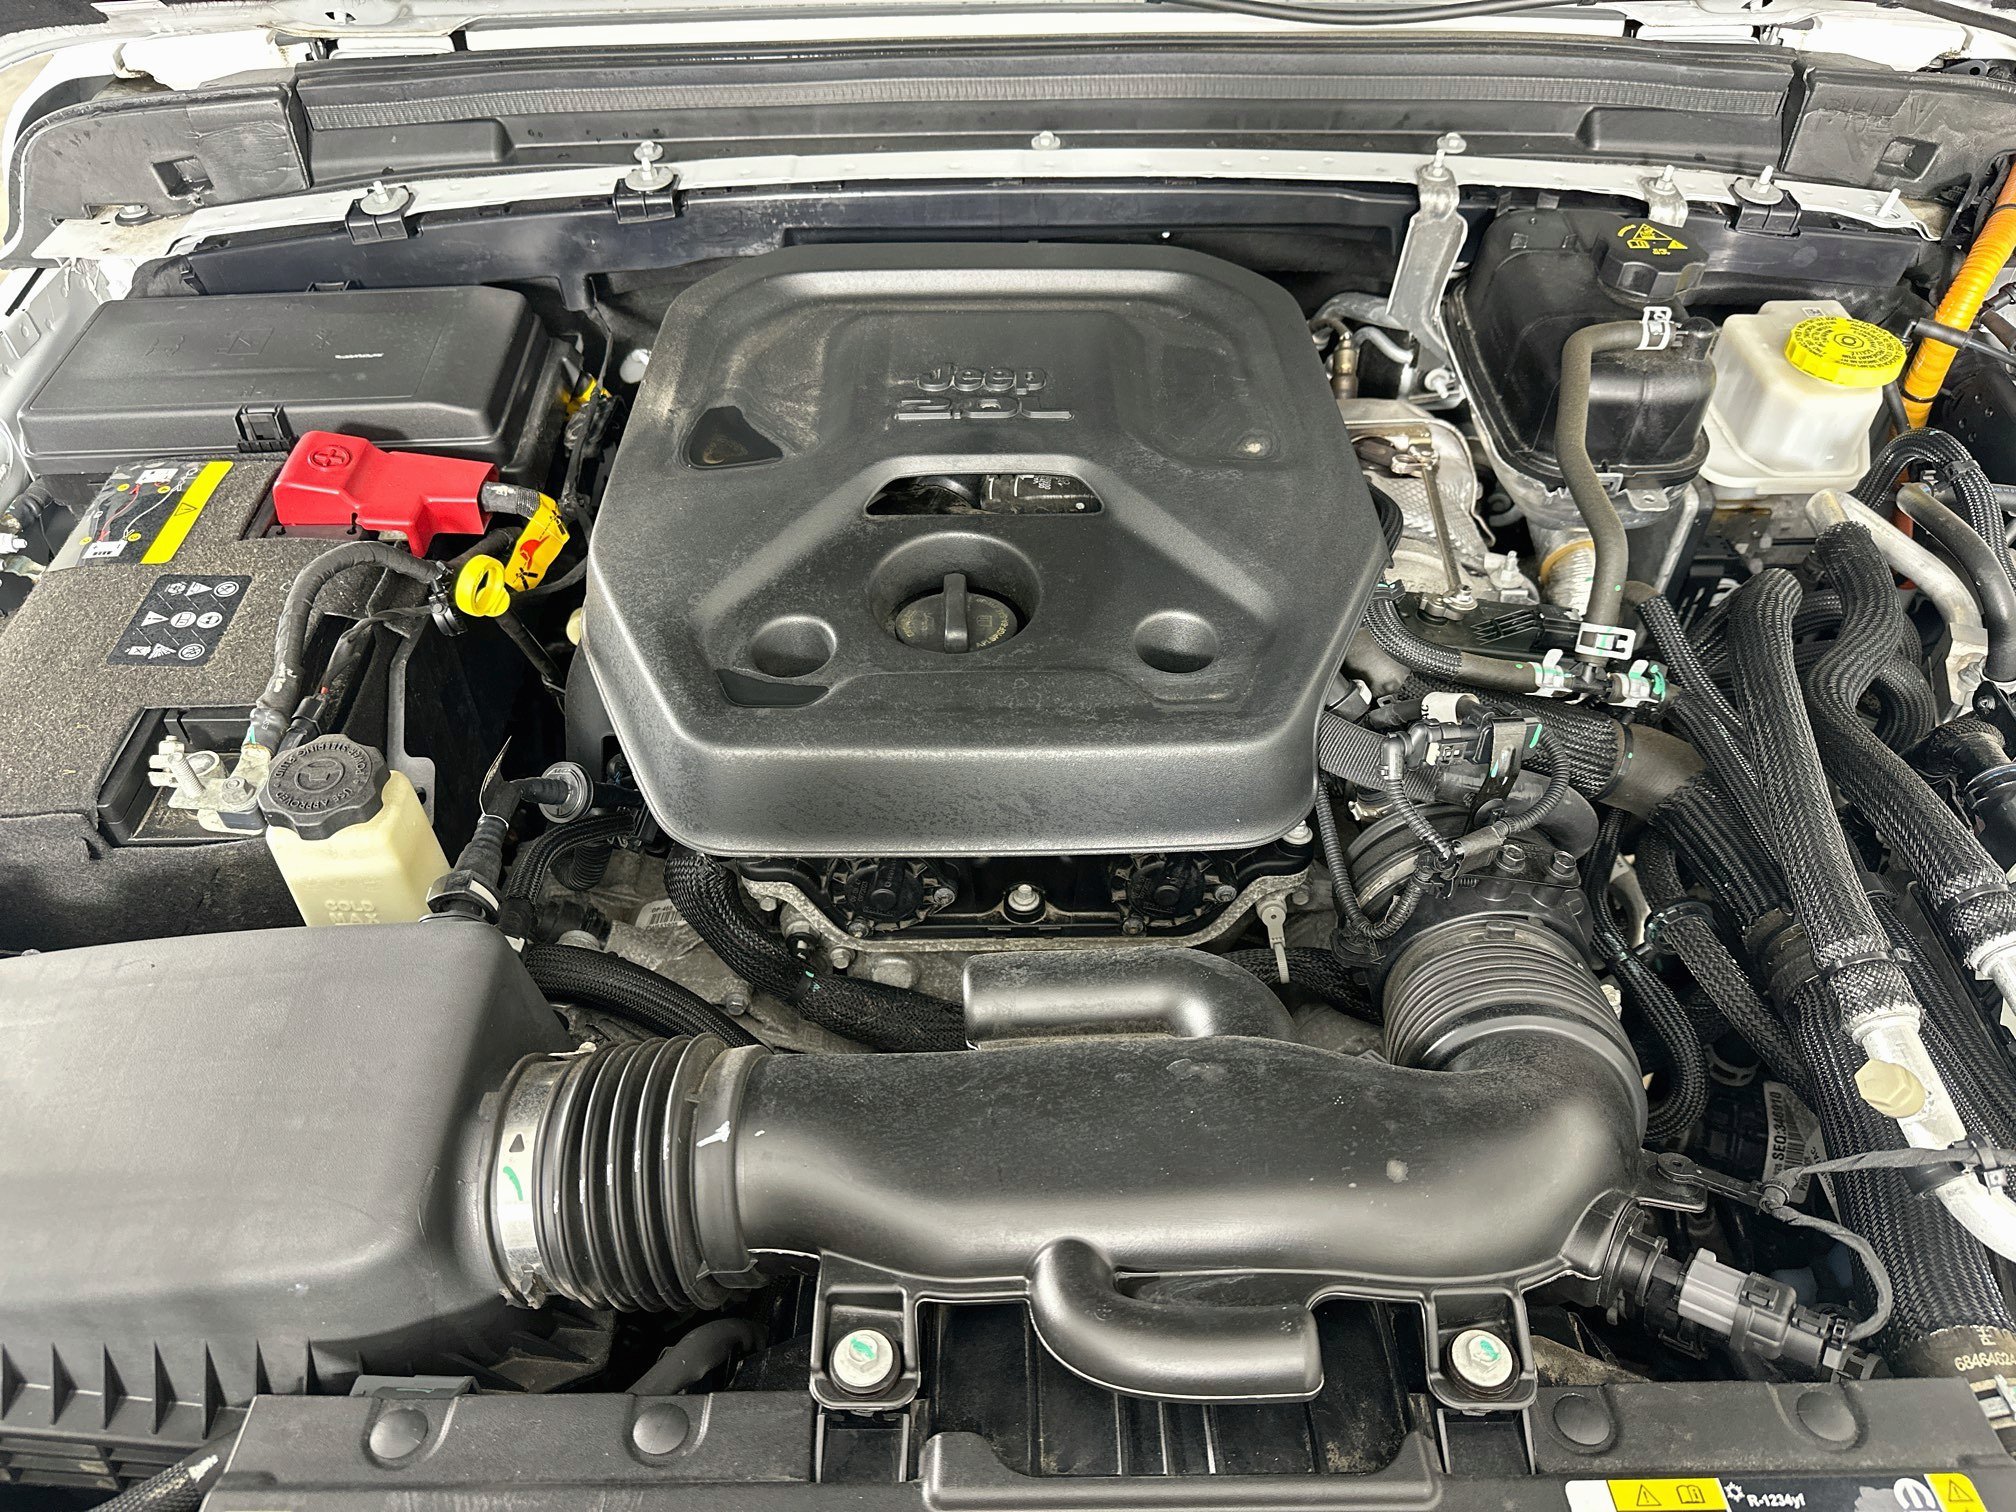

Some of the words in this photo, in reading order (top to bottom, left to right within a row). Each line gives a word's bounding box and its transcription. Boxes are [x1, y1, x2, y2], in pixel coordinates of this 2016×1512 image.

[915, 363, 1047, 396] Jeep
[895, 396, 1074, 421] 2.0L
[297, 742, 350, 757] STEERING
[275, 755, 298, 778] FLUID
[347, 748, 369, 776] POWER
[275, 791, 330, 809] APPROVED
[331, 787, 353, 802] USE
[324, 899, 376, 912] COLD
[328, 912, 380, 924] MAX
